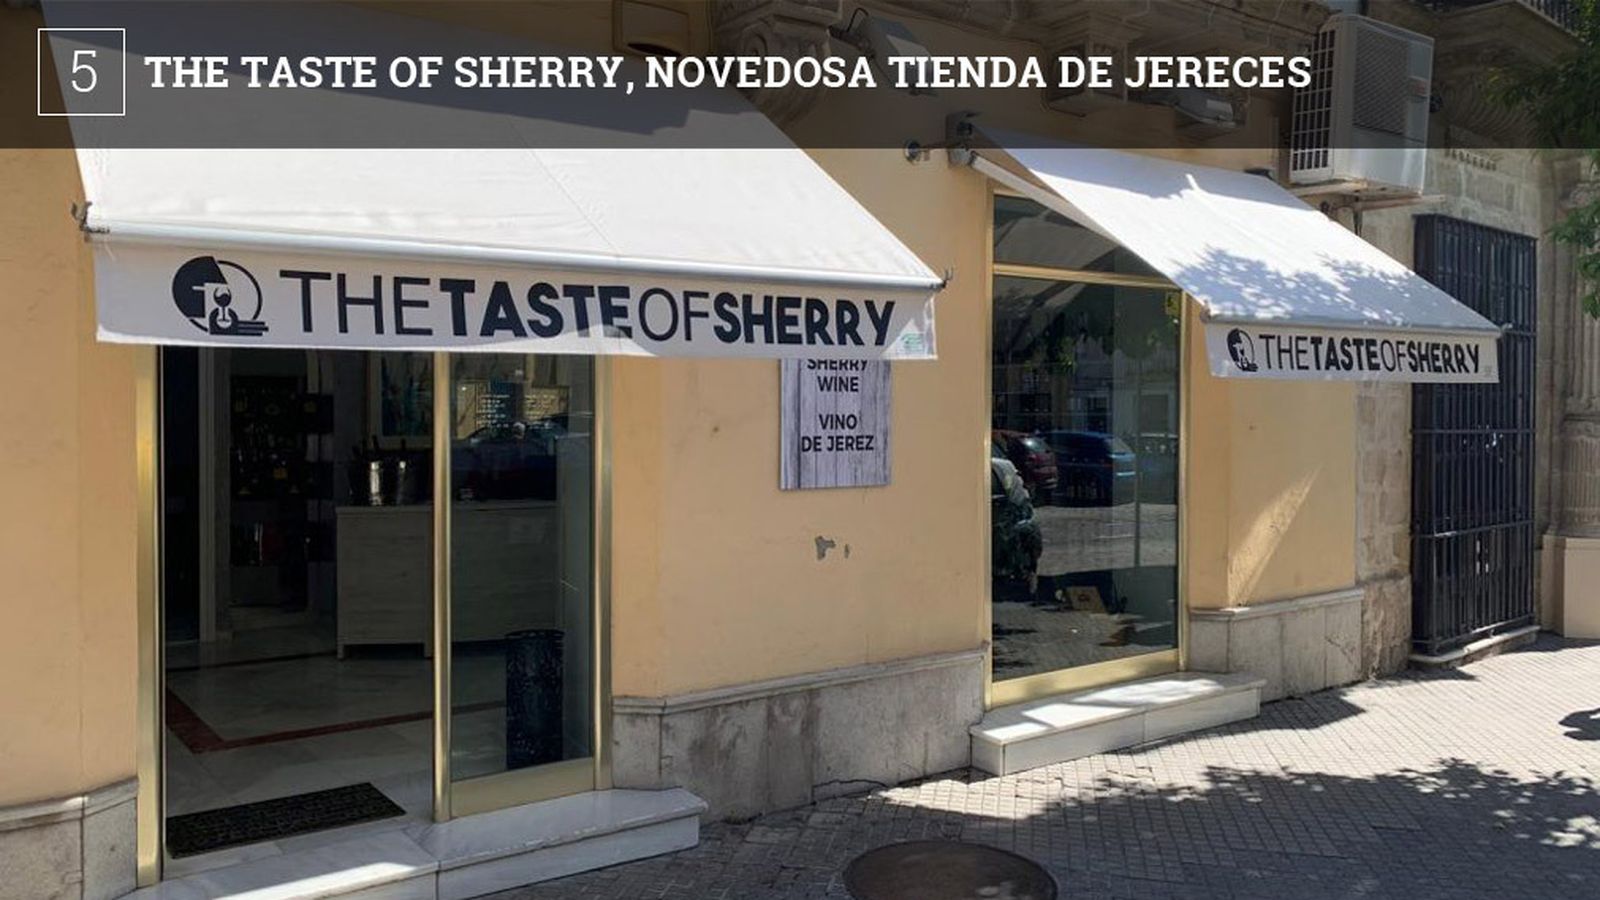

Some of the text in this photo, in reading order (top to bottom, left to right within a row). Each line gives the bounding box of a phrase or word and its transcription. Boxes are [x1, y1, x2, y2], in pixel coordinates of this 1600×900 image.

[807, 359, 868, 371] SHERRY
[817, 375, 859, 392] WINE
[818, 413, 858, 430] VINO
[801, 434, 875, 453] DE JEREZ
